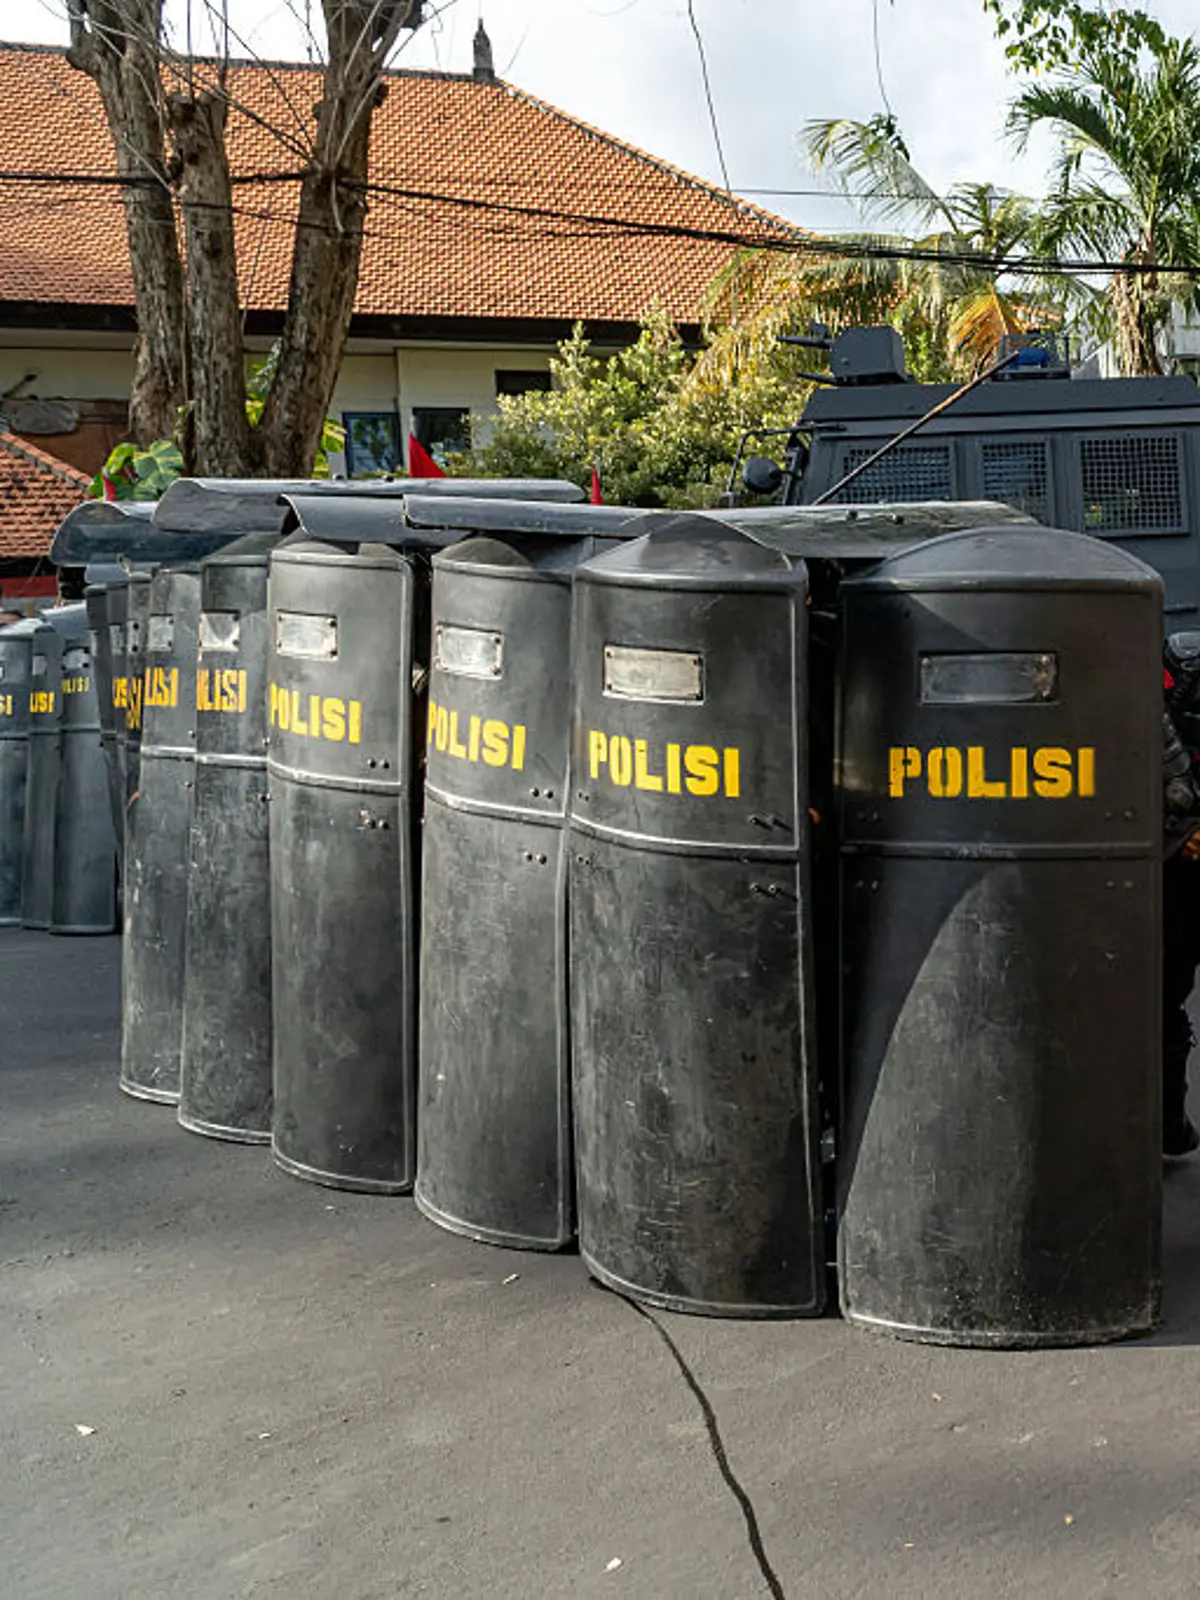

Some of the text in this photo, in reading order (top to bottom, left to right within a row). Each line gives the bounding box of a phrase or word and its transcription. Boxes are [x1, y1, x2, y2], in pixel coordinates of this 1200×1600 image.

[269, 682, 362, 744] POLISI
[427, 699, 527, 771] POLISI
[588, 730, 741, 798] POLISI
[889, 746, 1096, 799] POLISI
